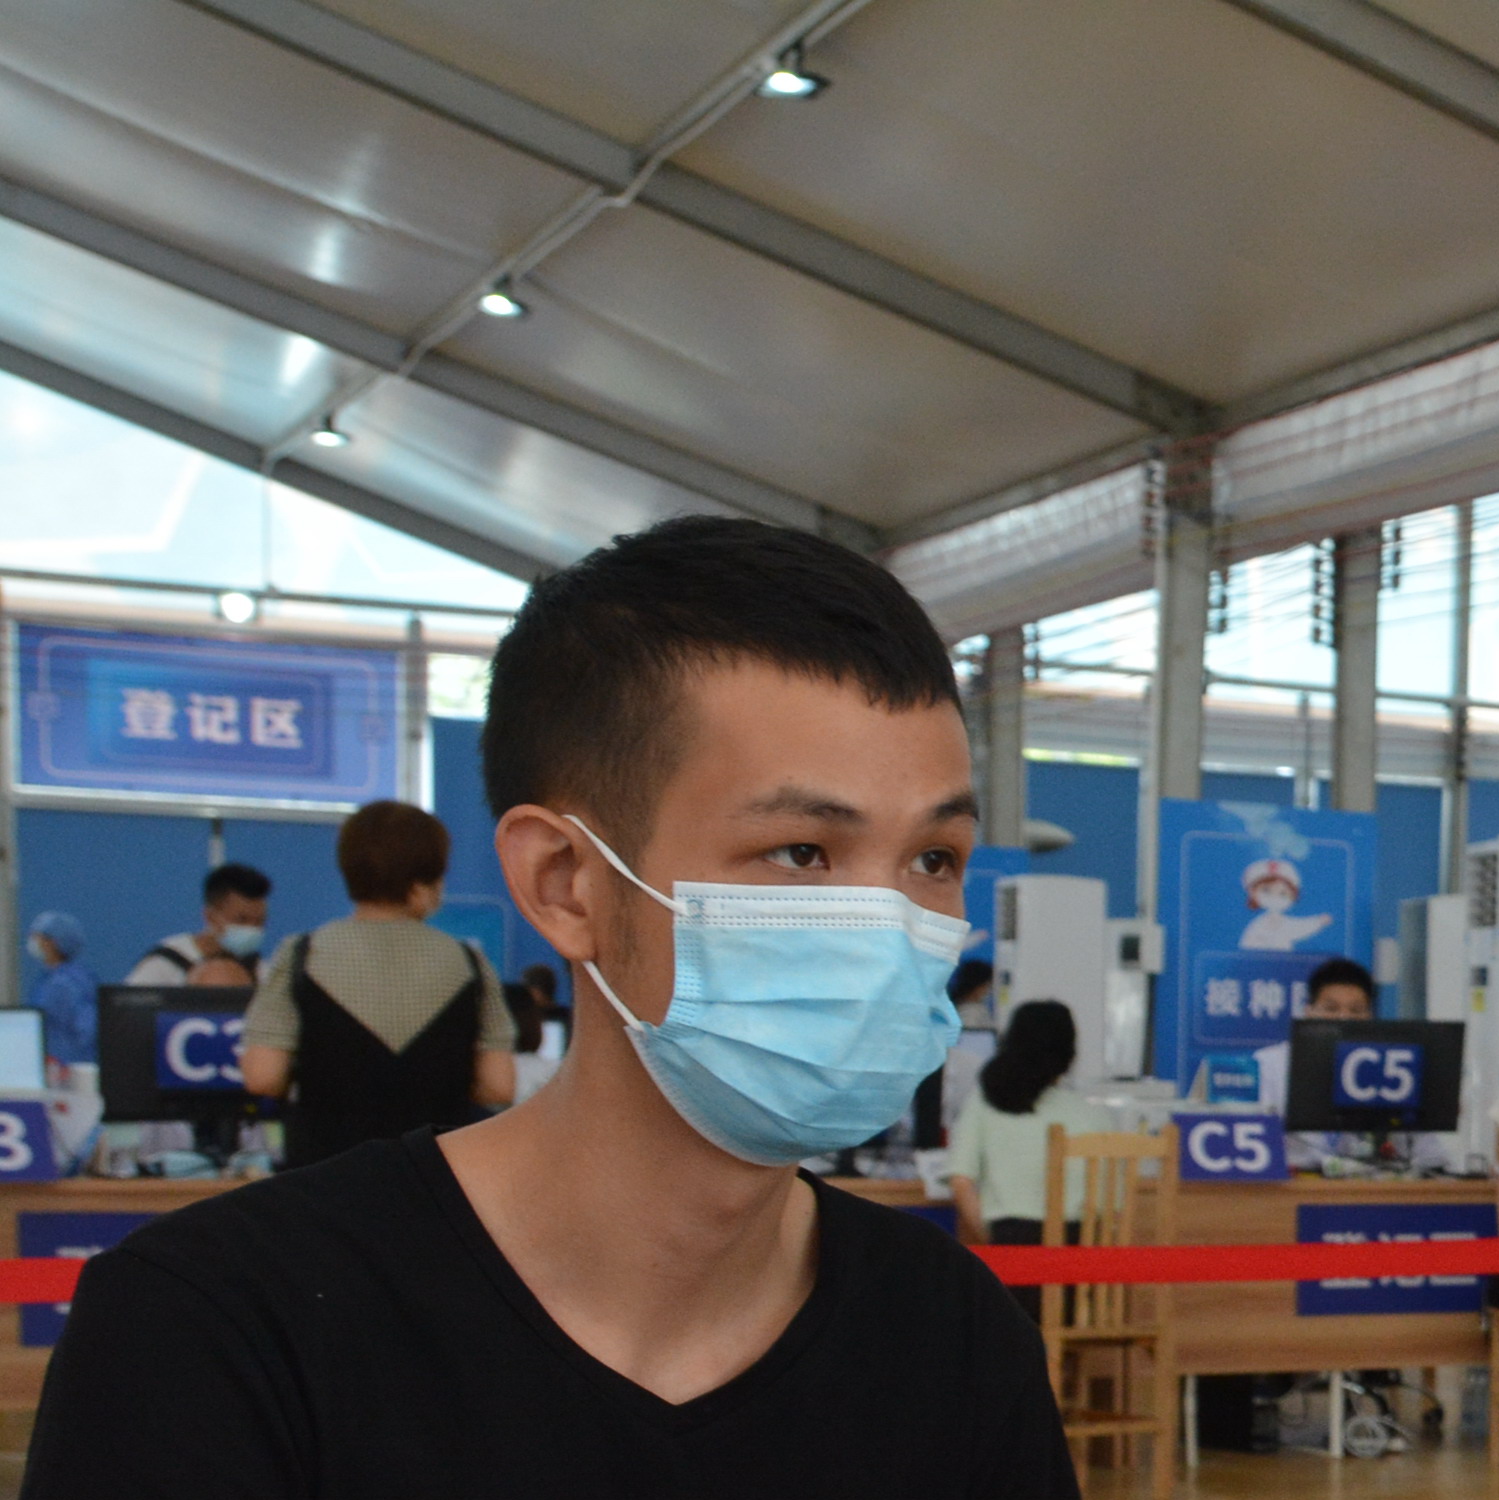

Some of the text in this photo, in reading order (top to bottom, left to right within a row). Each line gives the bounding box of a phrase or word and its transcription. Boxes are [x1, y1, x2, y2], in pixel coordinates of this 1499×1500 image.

[120, 689, 304, 750] 登记区
[1341, 1048, 1415, 1102] C5
[1188, 1123, 1271, 1172] C5
